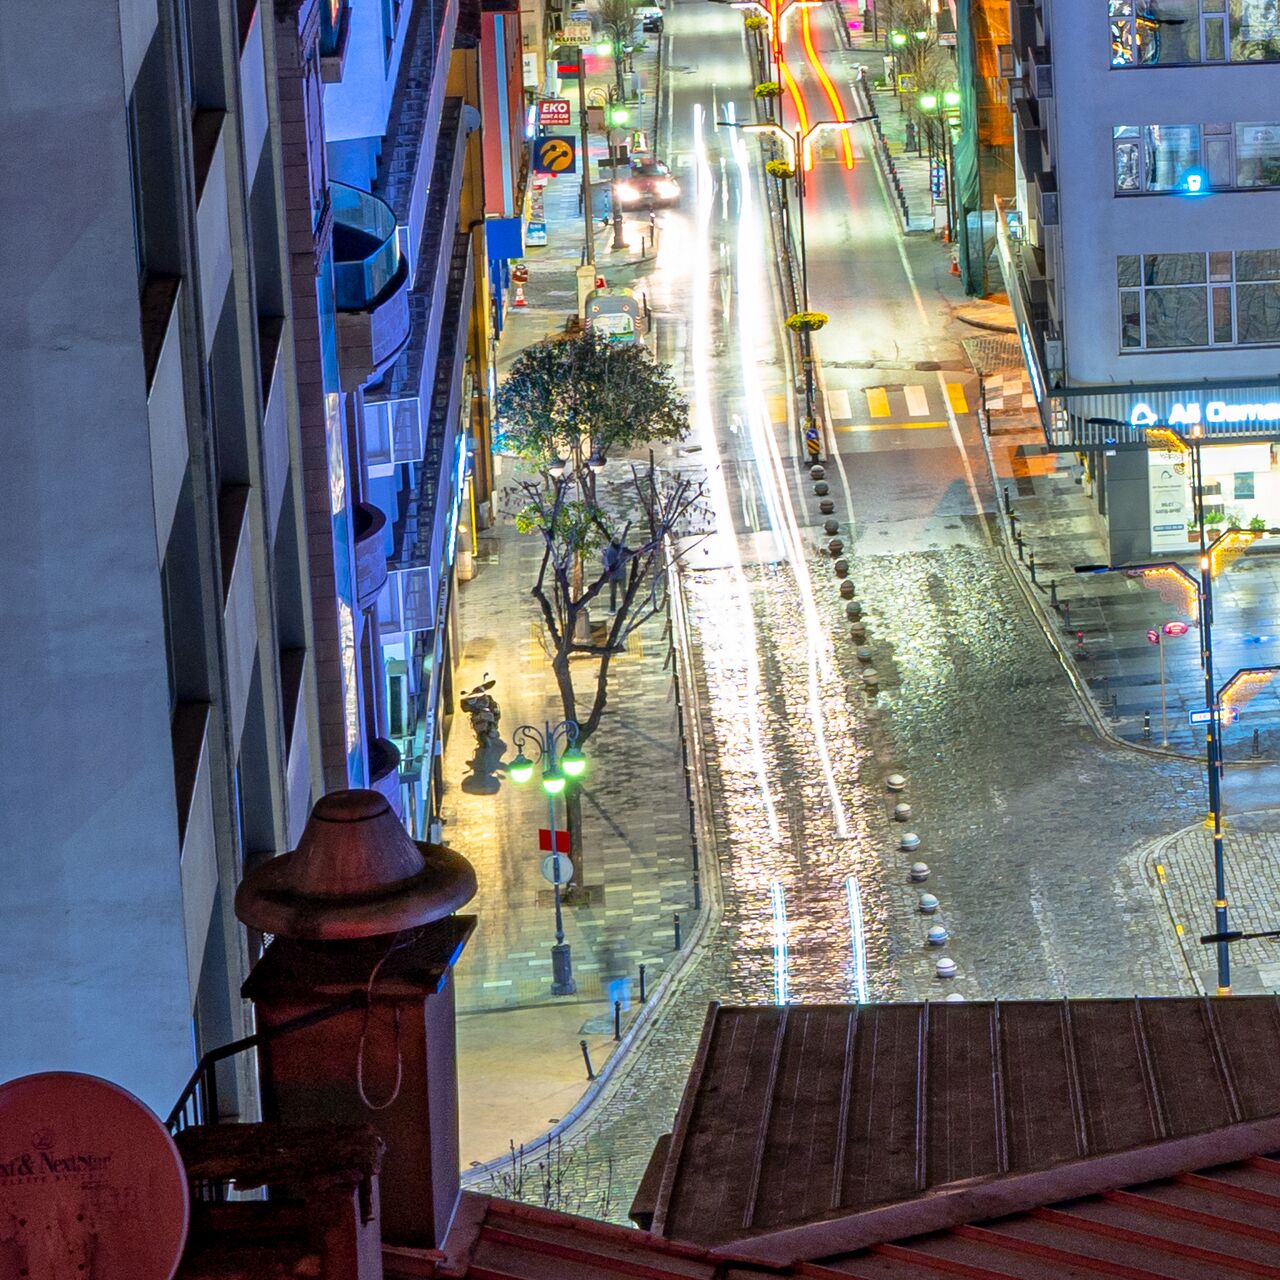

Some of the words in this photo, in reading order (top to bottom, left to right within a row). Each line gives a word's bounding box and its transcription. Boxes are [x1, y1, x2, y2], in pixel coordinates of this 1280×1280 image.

[554, 35, 591, 43] KURSU
[542, 103, 568, 112] EKO
[1168, 403, 1202, 425] Ali
